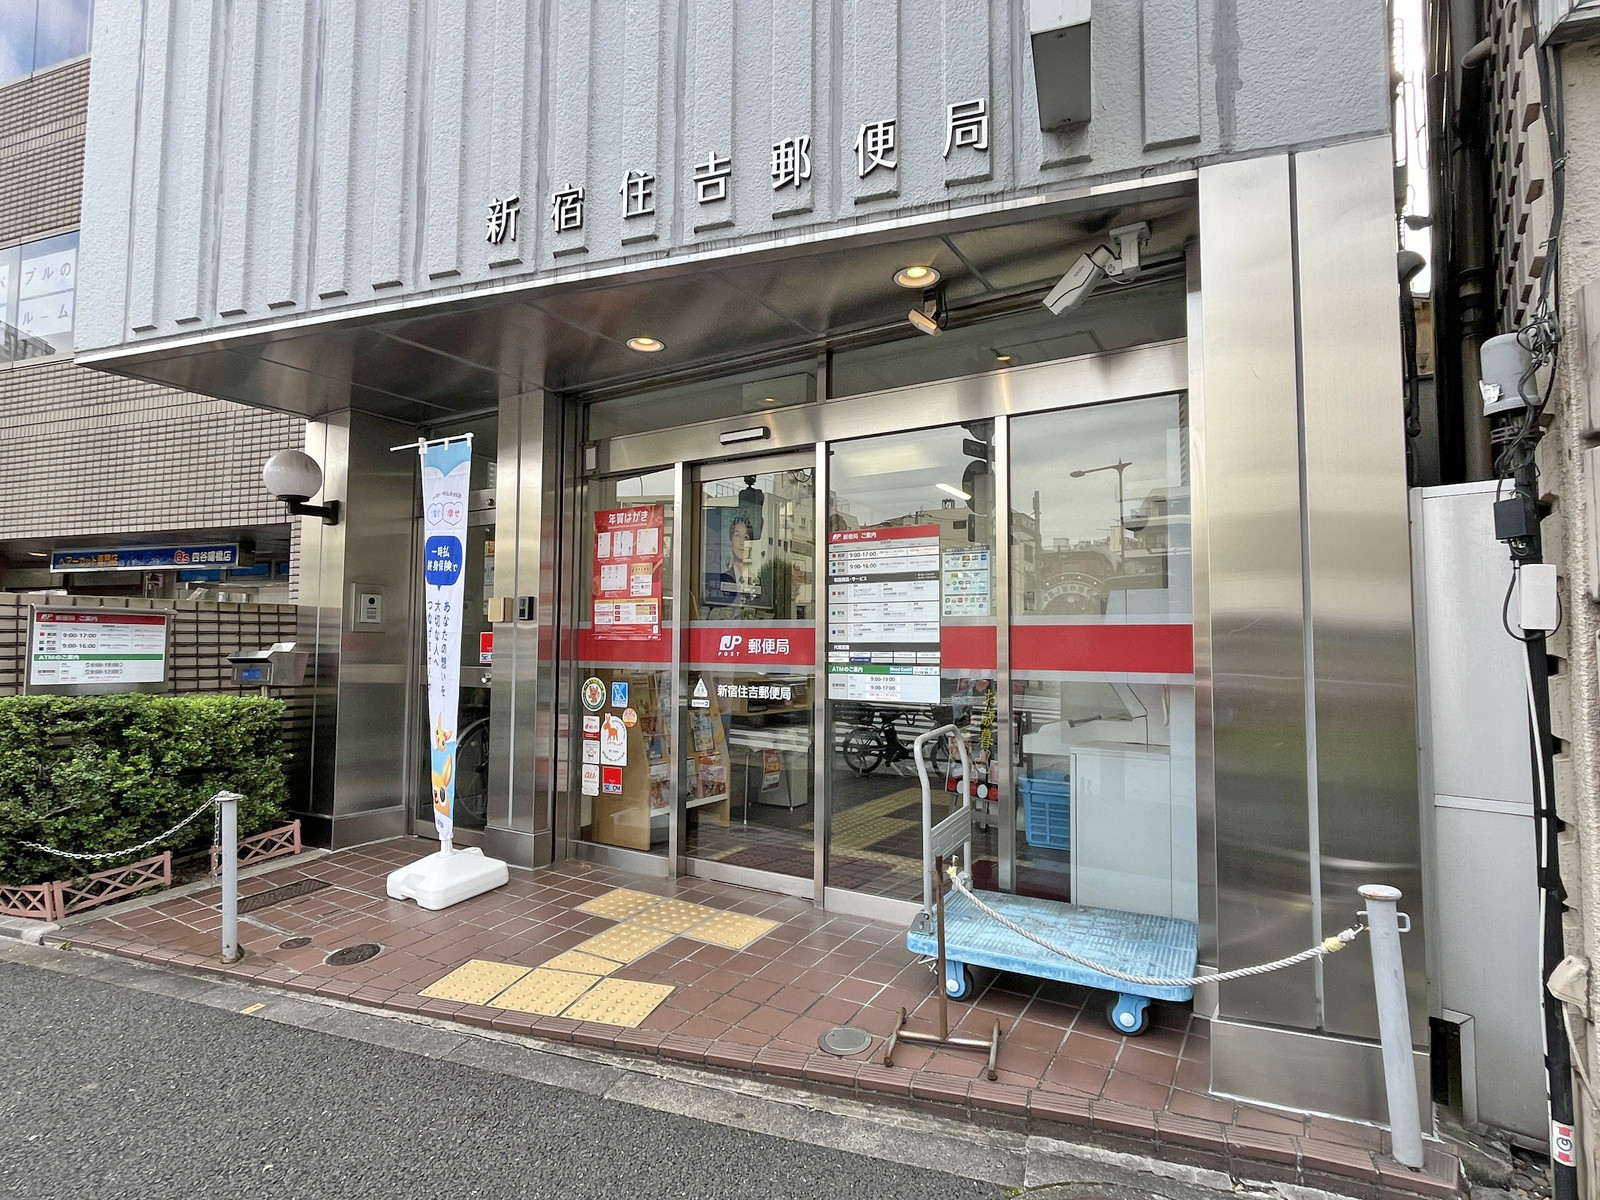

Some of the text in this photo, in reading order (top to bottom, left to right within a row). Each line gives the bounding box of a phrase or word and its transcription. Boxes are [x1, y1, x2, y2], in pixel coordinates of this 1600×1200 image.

[485, 97, 990, 244] 新宿住吉郵便局
[22, 304, 68, 326] ルーム
[608, 510, 648, 525] 年賀はがき
[431, 546, 450, 558] 一時払
[433, 599, 441, 667] 大切な人へ
[440, 601, 451, 697] あなたの想いを
[747, 638, 790, 655] 郵便局
[717, 684, 792, 701] 新宿住吉郵便局
[979, 689, 998, 749] お歳暮
[584, 771, 598, 779] au
